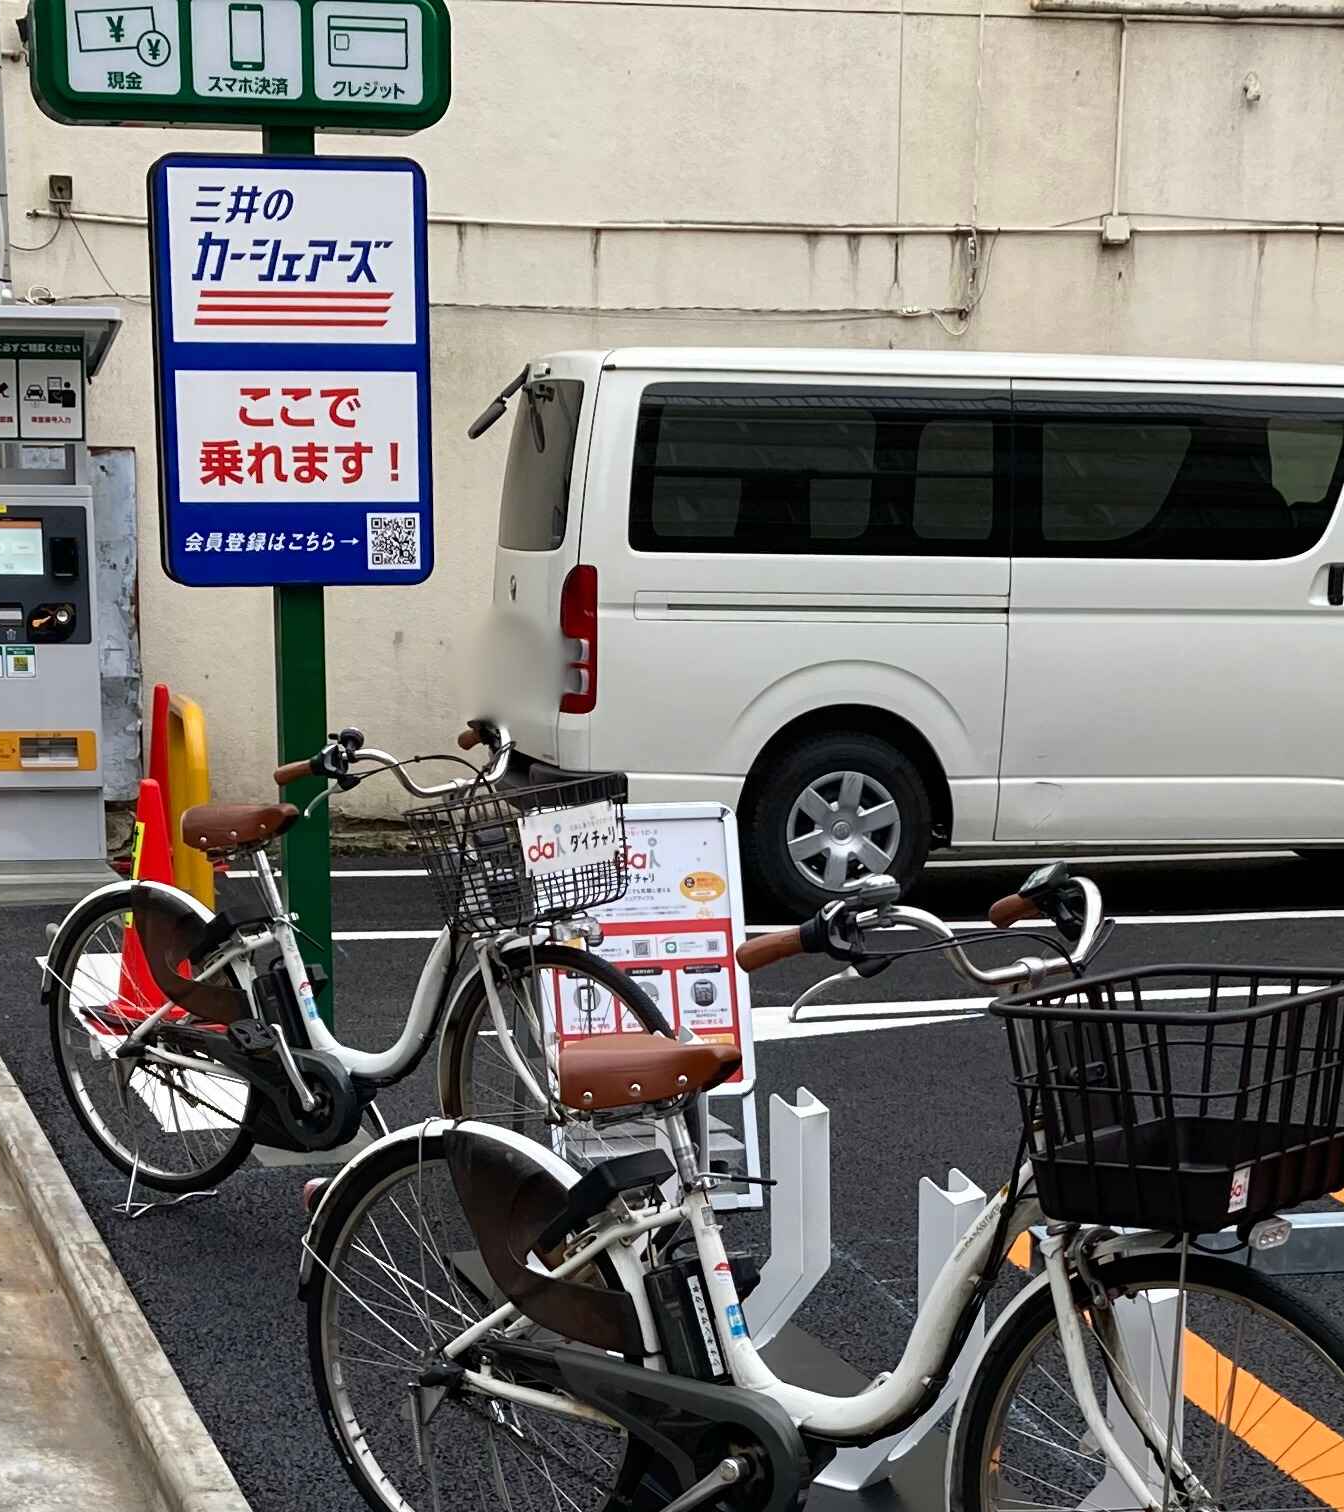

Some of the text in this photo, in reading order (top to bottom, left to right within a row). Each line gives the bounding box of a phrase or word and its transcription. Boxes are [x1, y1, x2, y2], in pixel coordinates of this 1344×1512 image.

[107, 71, 143, 90] 現金
[208, 76, 288, 96] スマホ決済
[332, 80, 405, 100] クレジット
[190, 185, 294, 223] 三井の
[191, 232, 393, 283] カーシェアーズ
[239, 388, 361, 427] ここで
[199, 440, 400, 486] 乗れます！
[184, 532, 336, 552] 会員登録はこちら
